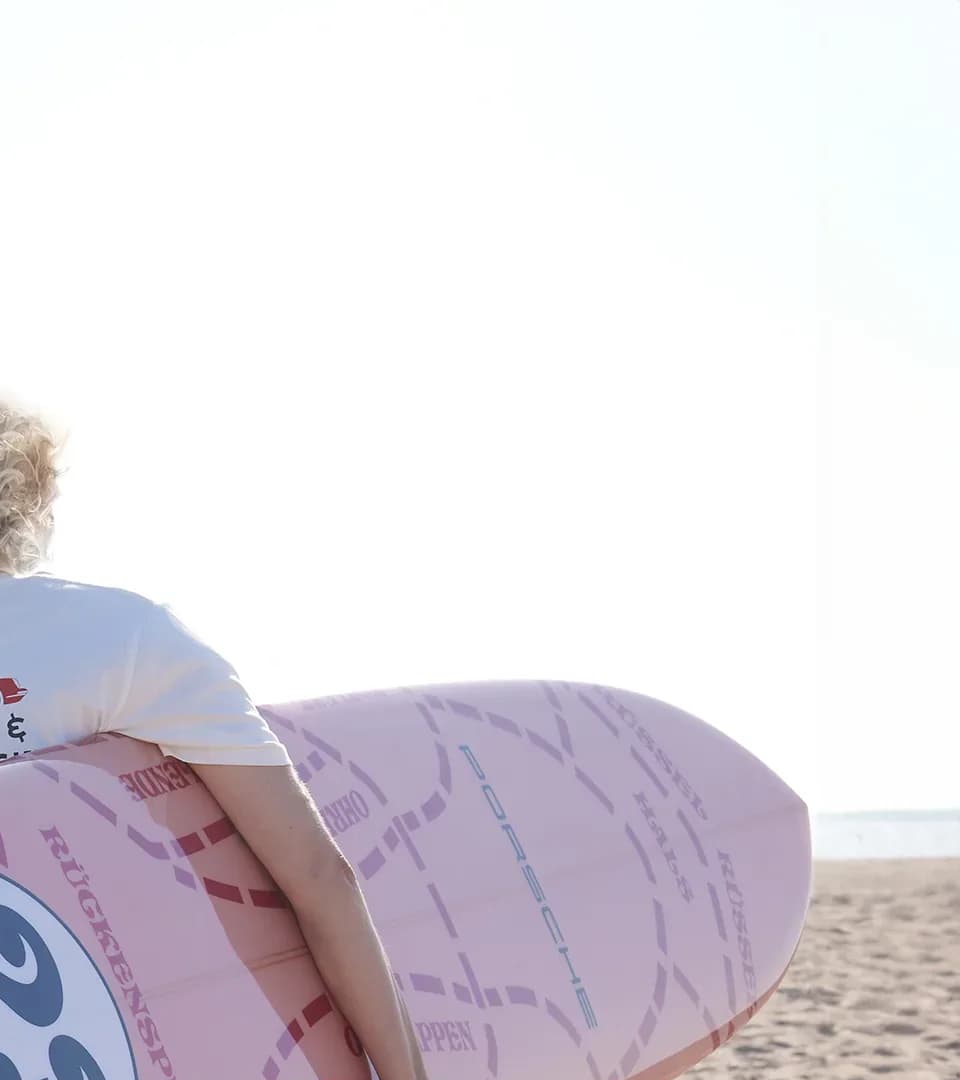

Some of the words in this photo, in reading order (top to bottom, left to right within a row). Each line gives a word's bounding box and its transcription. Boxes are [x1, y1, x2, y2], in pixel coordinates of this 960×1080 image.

[6, 712, 27, 743] &
[458, 744, 599, 1031] PORSCHE
[414, 1019, 478, 1053] PPEN
